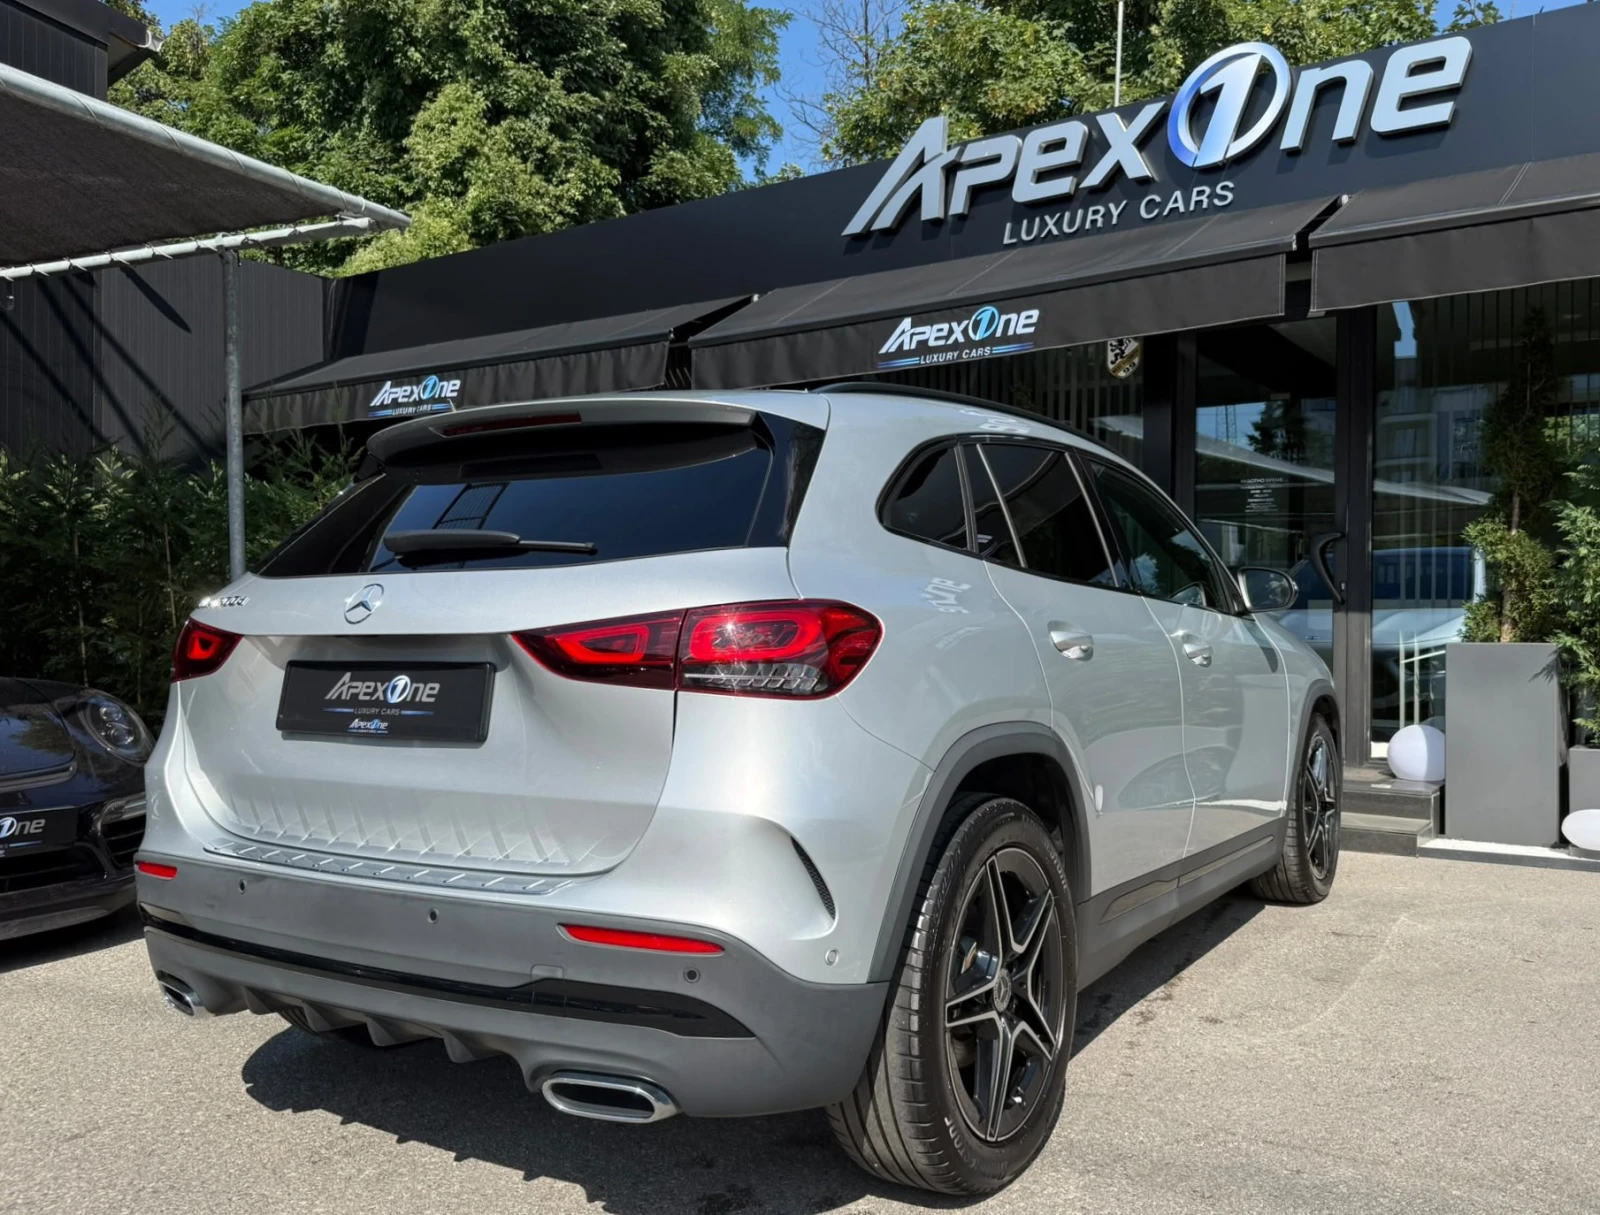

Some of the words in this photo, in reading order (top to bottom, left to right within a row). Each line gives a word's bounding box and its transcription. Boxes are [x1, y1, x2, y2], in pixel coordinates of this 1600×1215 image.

[1002, 200, 1127, 246] LUXURY
[1139, 181, 1235, 221] CARS
[920, 350, 959, 364] LUXURY
[962, 346, 991, 359] CARS
[392, 407, 416, 416] LUXURY
[416, 403, 432, 413] CARS
[354, 707, 379, 715] LUXURY
[381, 707, 401, 716] CARS
